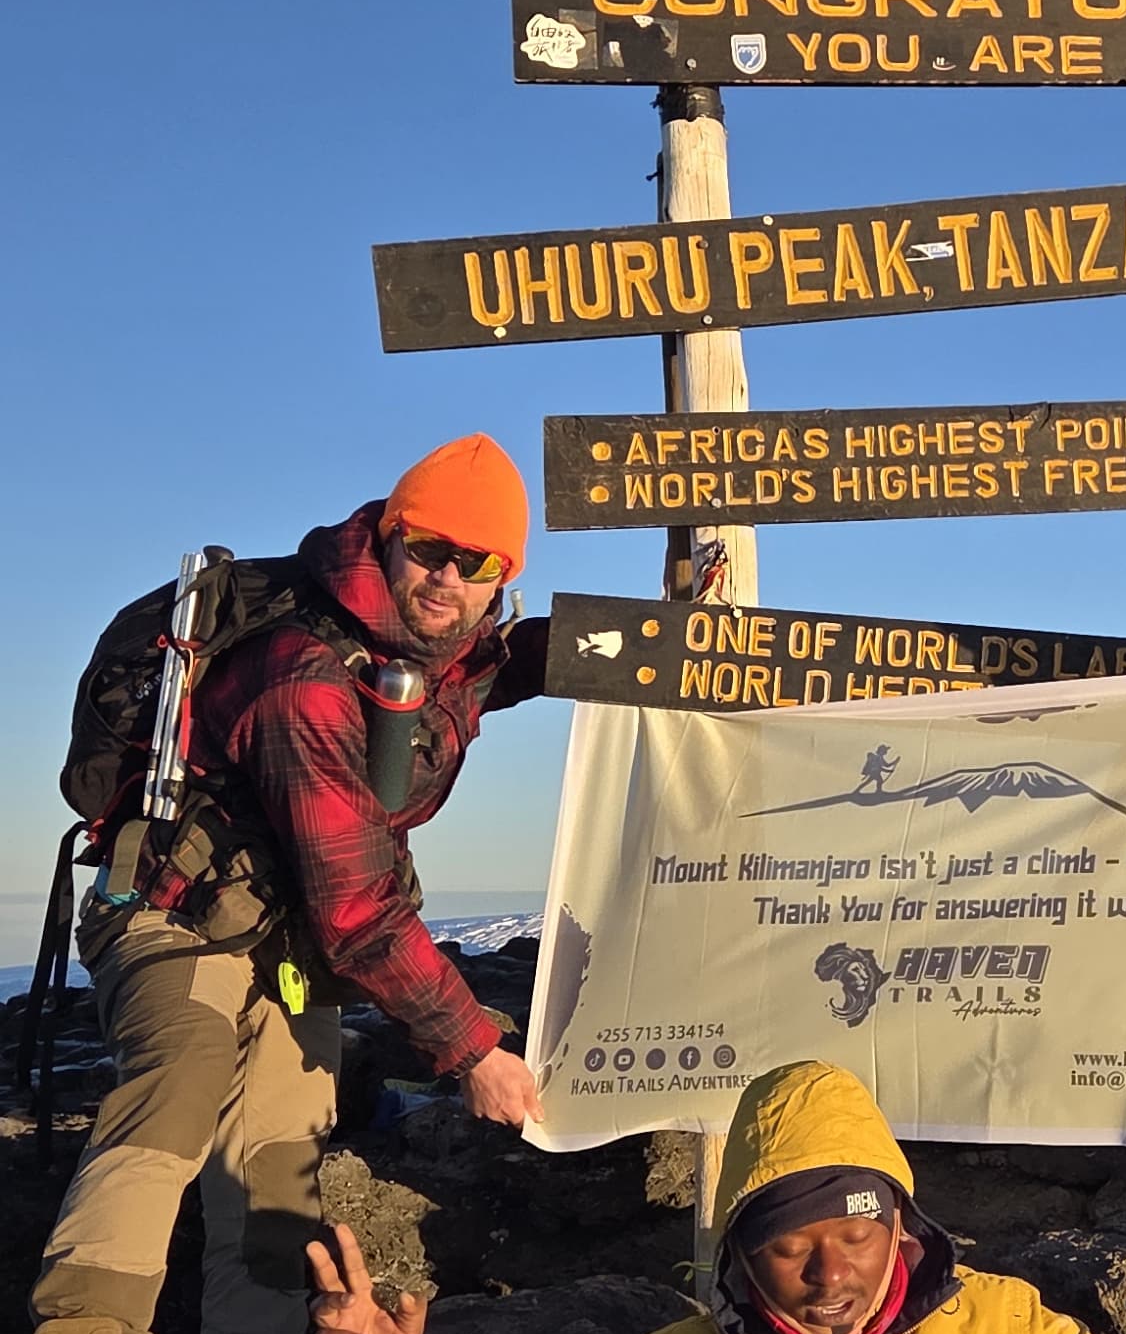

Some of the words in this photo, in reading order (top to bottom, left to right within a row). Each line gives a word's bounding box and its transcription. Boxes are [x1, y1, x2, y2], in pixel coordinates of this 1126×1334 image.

[787, 33, 920, 73] YOU
[969, 34, 1102, 74] ARE
[464, 234, 711, 327] UHURU
[624, 427, 830, 466] AFRICAS
[845, 419, 1034, 459] HIGHEST
[623, 468, 817, 509] WORLD'S
[832, 460, 1029, 503] HIGHEST
[685, 610, 777, 658] ONE
[788, 620, 843, 662] OF
[854, 625, 1040, 679] WORLD'S
[679, 659, 832, 707] WORLD
[652, 853, 729, 885] Mount
[737, 852, 871, 888] Kilimanjaro
[879, 850, 938, 881] isn't
[937, 850, 994, 886] just
[1002, 855, 1018, 875] a
[1026, 846, 1097, 875] climb
[753, 894, 831, 925] Thank
[840, 895, 883, 922] You
[890, 896, 929, 921] for
[935, 890, 1067, 926] answering
[1076, 889, 1097, 919] it
[894, 944, 1051, 984] HAVEN
[888, 985, 1042, 1004] TRAILS
[596, 1026, 631, 1044] +255
[635, 1026, 663, 1041] 713
[666, 1023, 726, 1041] 334154
[846, 1190, 881, 1215] BREAK
